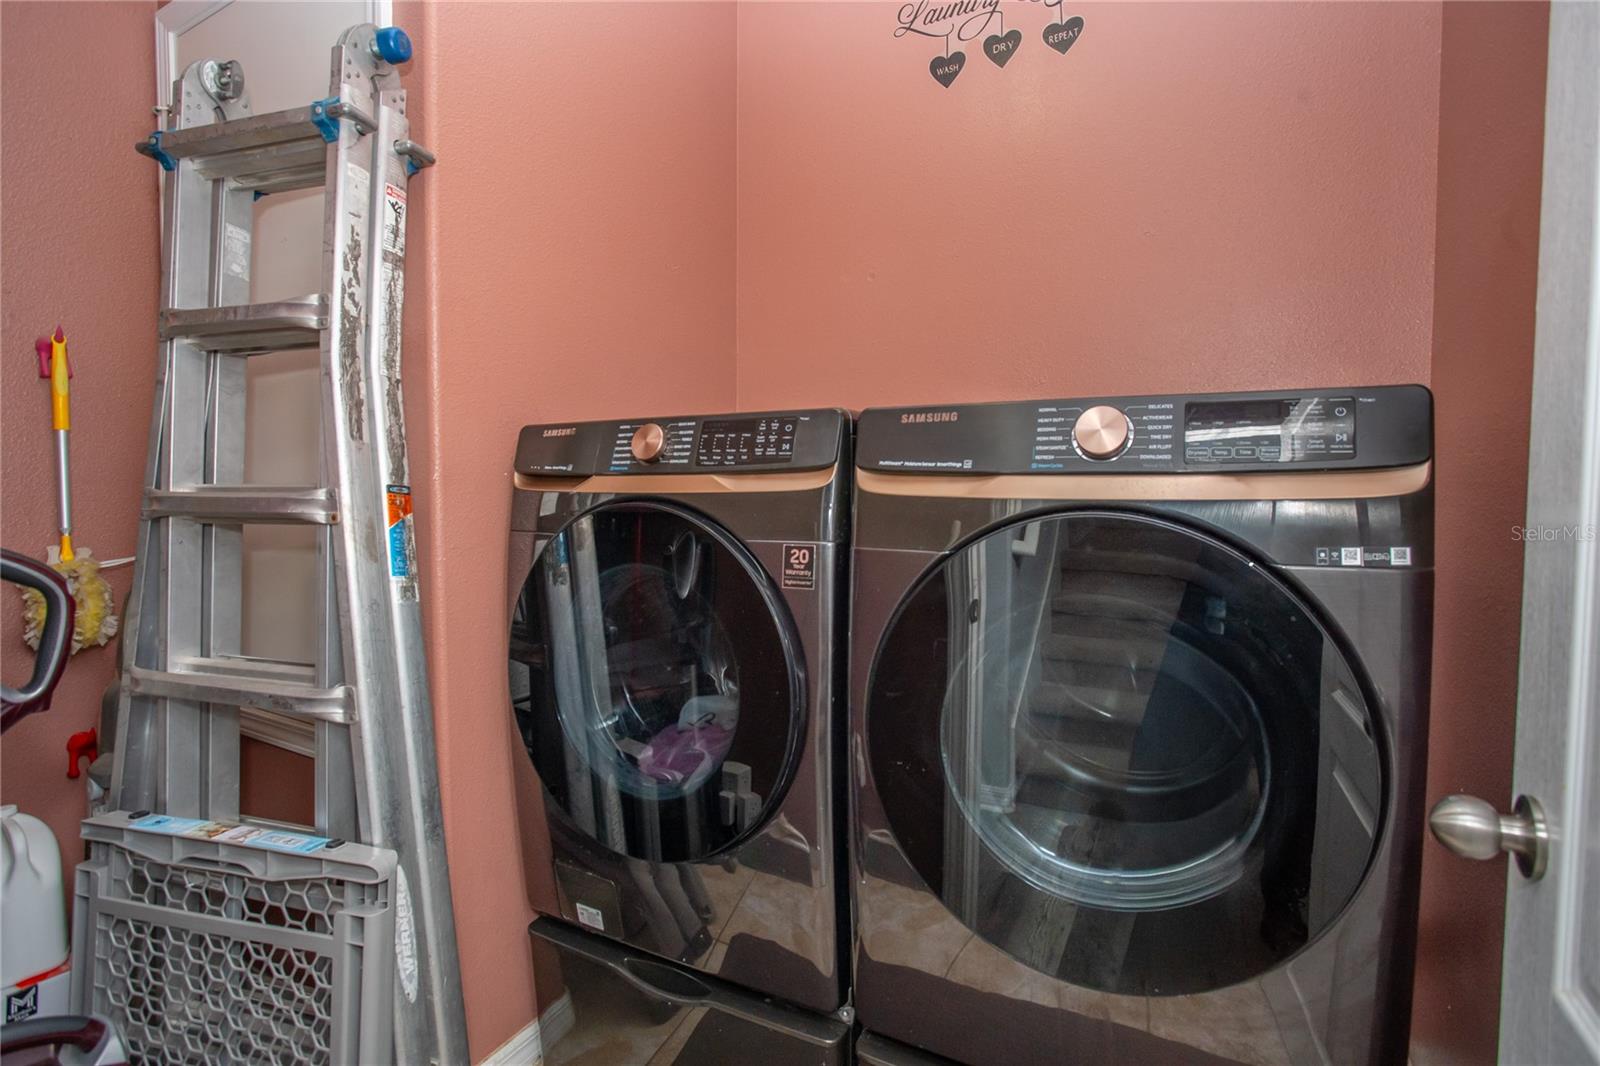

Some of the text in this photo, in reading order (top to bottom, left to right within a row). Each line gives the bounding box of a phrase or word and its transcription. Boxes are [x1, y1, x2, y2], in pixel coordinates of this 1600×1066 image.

[1048, 27, 1079, 45] REPEAT
[992, 40, 1014, 54] DRY
[936, 64, 959, 76] WASH
[900, 411, 958, 424] SAMSUNG
[542, 427, 576, 438] SAMSUNG
[790, 549, 809, 564] 20
[396, 890, 414, 975] WERNER
